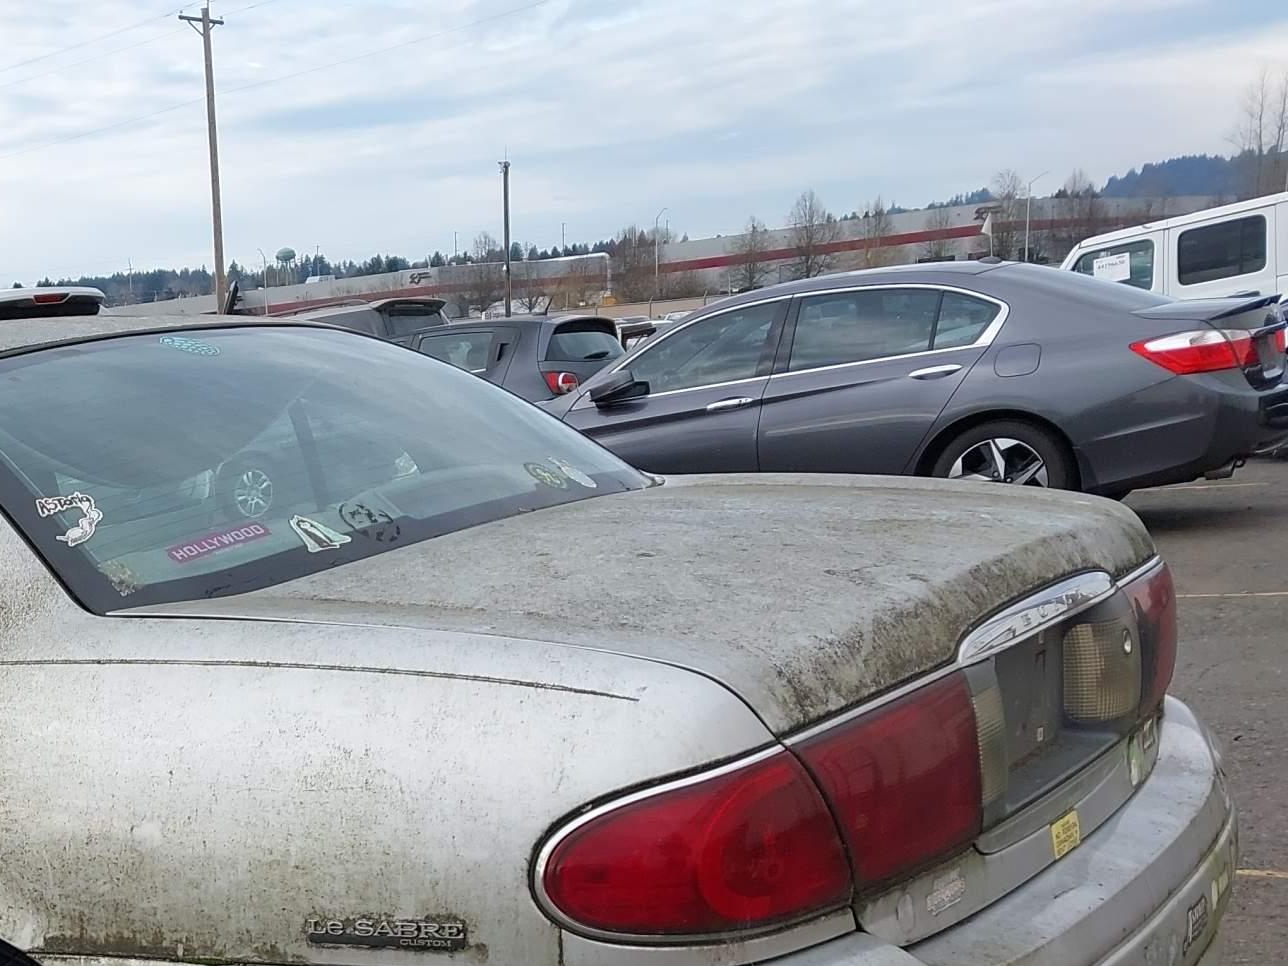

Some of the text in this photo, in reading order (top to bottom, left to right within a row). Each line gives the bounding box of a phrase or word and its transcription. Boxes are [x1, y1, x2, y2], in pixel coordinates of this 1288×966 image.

[172, 524, 264, 559] HOLLYWOOD
[354, 920, 465, 939] SABRE
[399, 938, 452, 947] CUSTOM
